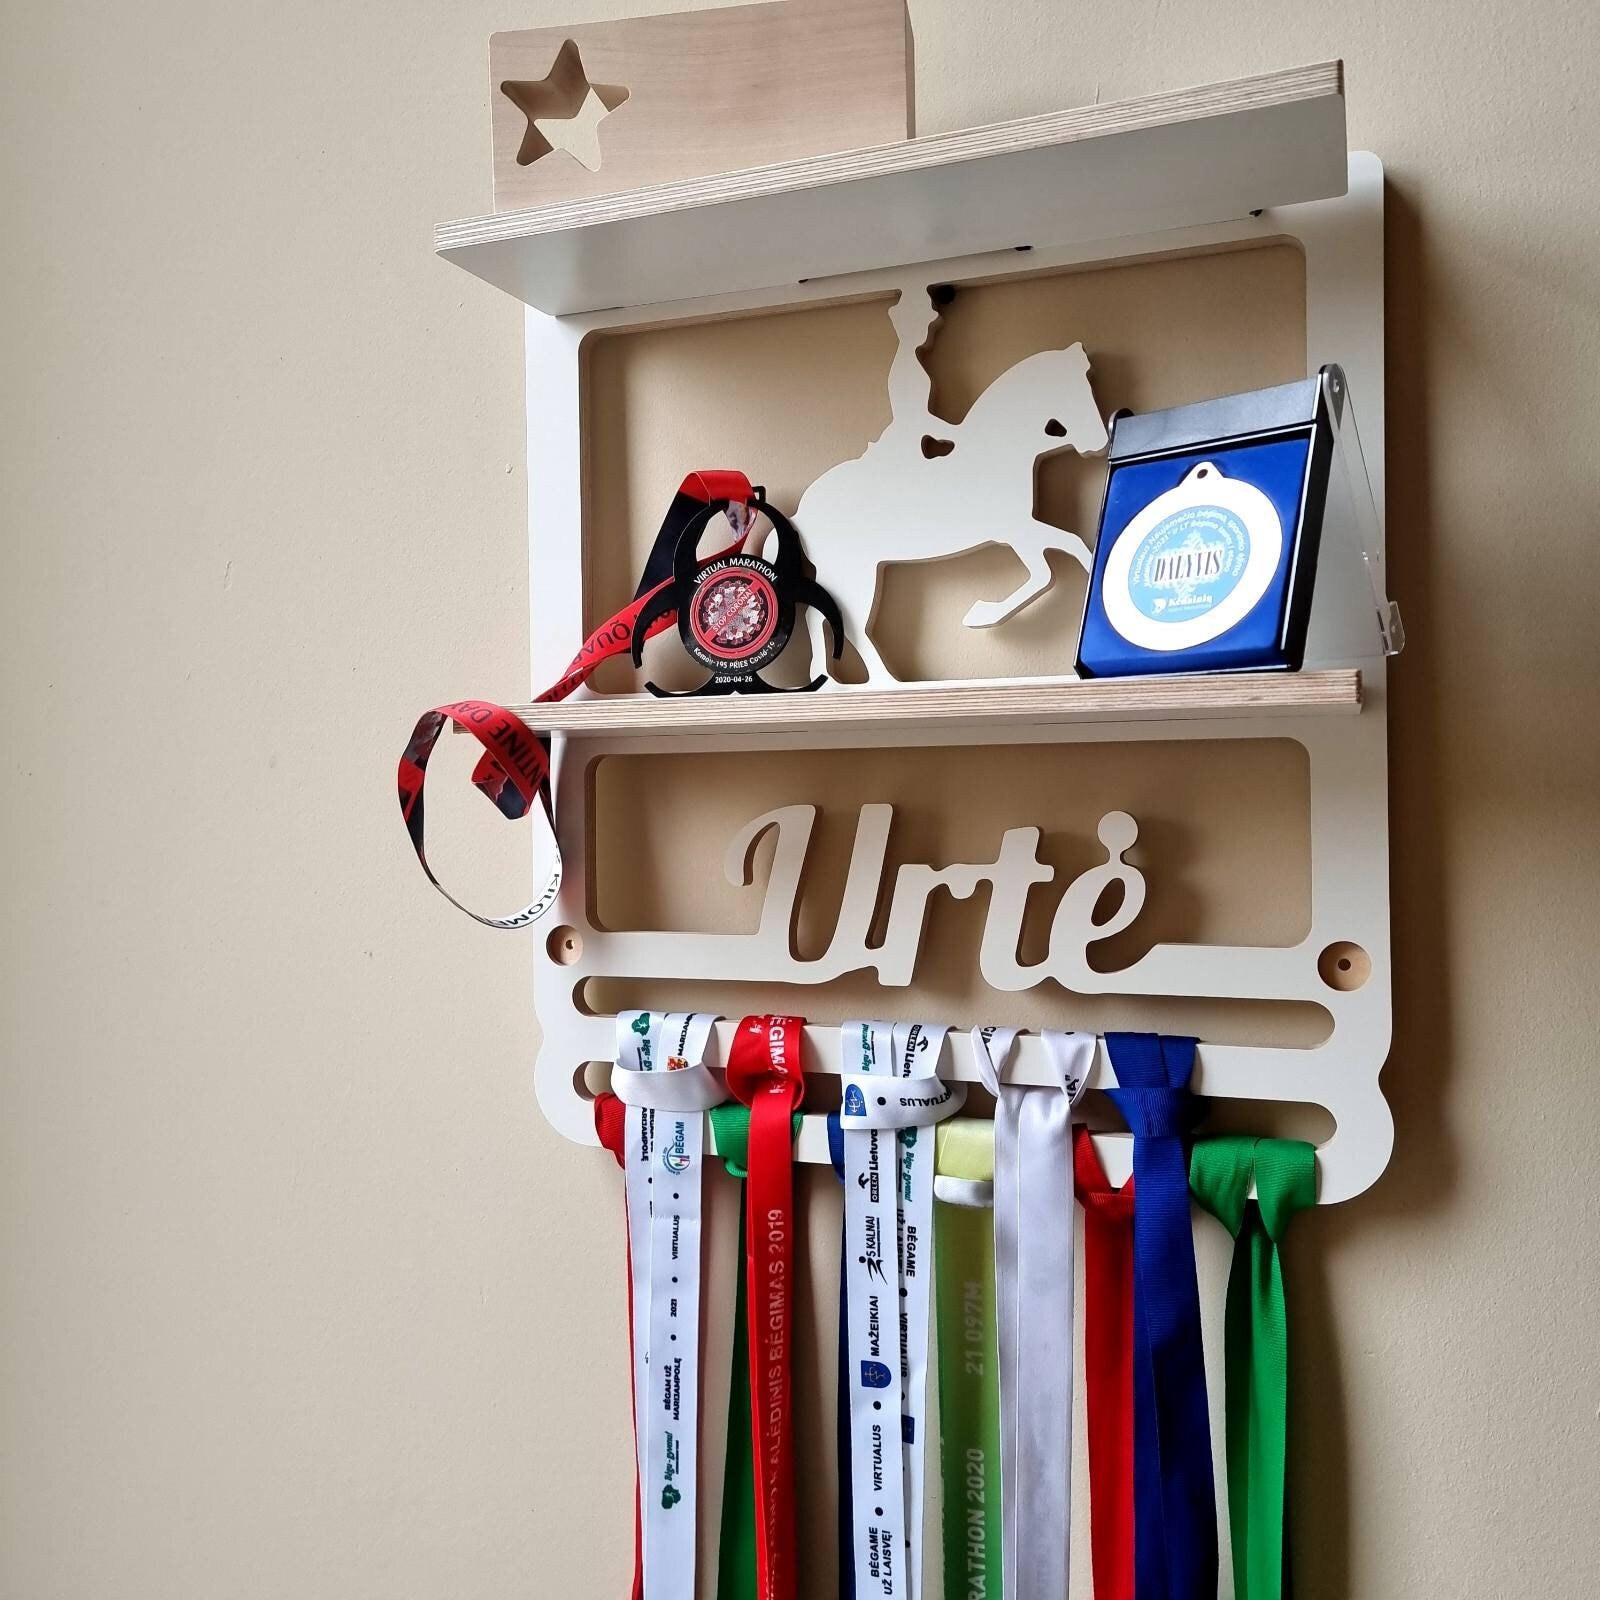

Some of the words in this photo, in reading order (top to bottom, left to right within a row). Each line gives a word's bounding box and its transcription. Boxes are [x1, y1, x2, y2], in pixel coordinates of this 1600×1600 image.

[694, 560, 727, 584] VIRTUAL
[730, 557, 778, 582] MARATHON
[712, 615, 727, 632] STOP
[715, 676, 753, 684] 2020-04-26
[724, 803, 1146, 994] Urtė
[906, 1025, 922, 1051] ORLEN
[870, 1172, 879, 1203] ORLEN
[672, 1214, 681, 1260] VIRTUALUS
[767, 1209, 785, 1256] 2019
[865, 1216, 875, 1248] KALNAI
[906, 1225, 919, 1278] BĖGAME
[765, 1260, 785, 1361] BĖGIMAS
[868, 1295, 880, 1357] MAŽEIKIAI
[966, 1350, 984, 1375] 21
[872, 1424, 882, 1491] VIRTUALUS
[966, 1448, 985, 1504] 2020
[868, 1526, 880, 1577] BĖGAME
[882, 1578, 893, 1595] UŽ
